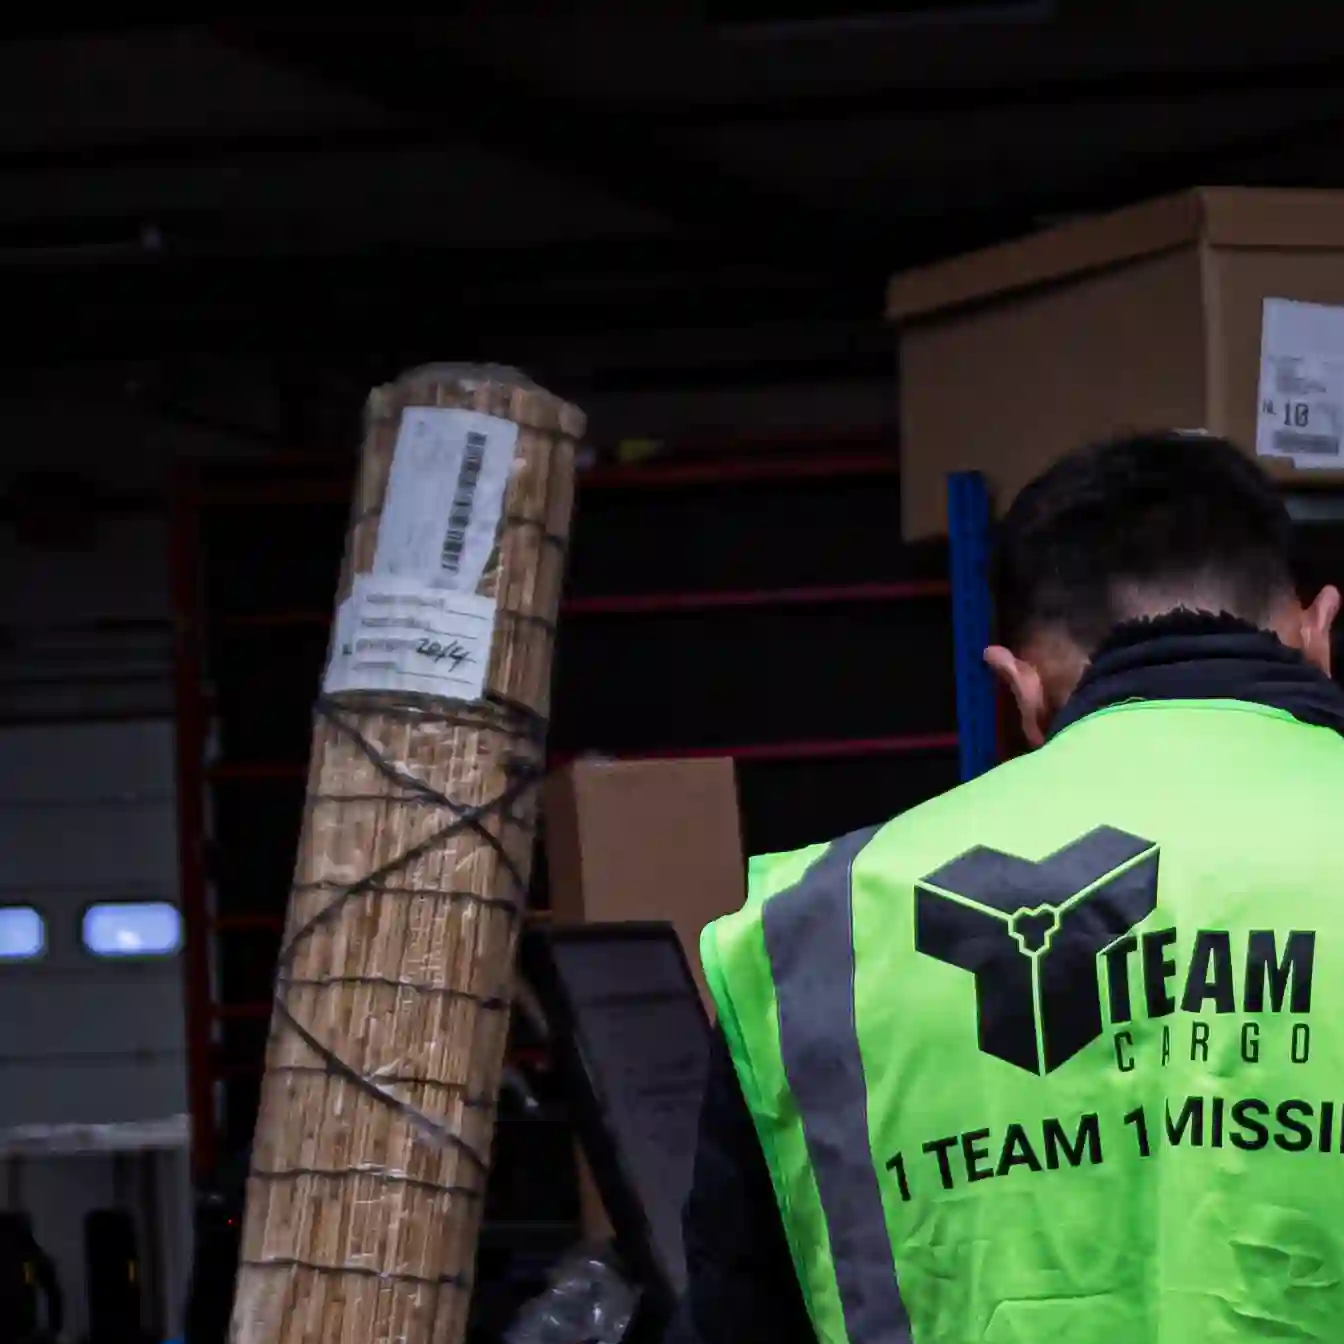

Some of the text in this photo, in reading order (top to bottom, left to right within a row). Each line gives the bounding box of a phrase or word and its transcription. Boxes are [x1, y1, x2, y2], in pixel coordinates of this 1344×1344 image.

[1103, 926, 1317, 1025] TEAM
[1114, 1020, 1311, 1074] CARGO
[886, 1151, 912, 1202] 1
[922, 1112, 1103, 1190] TEAM
[1124, 1106, 1151, 1157] 1
